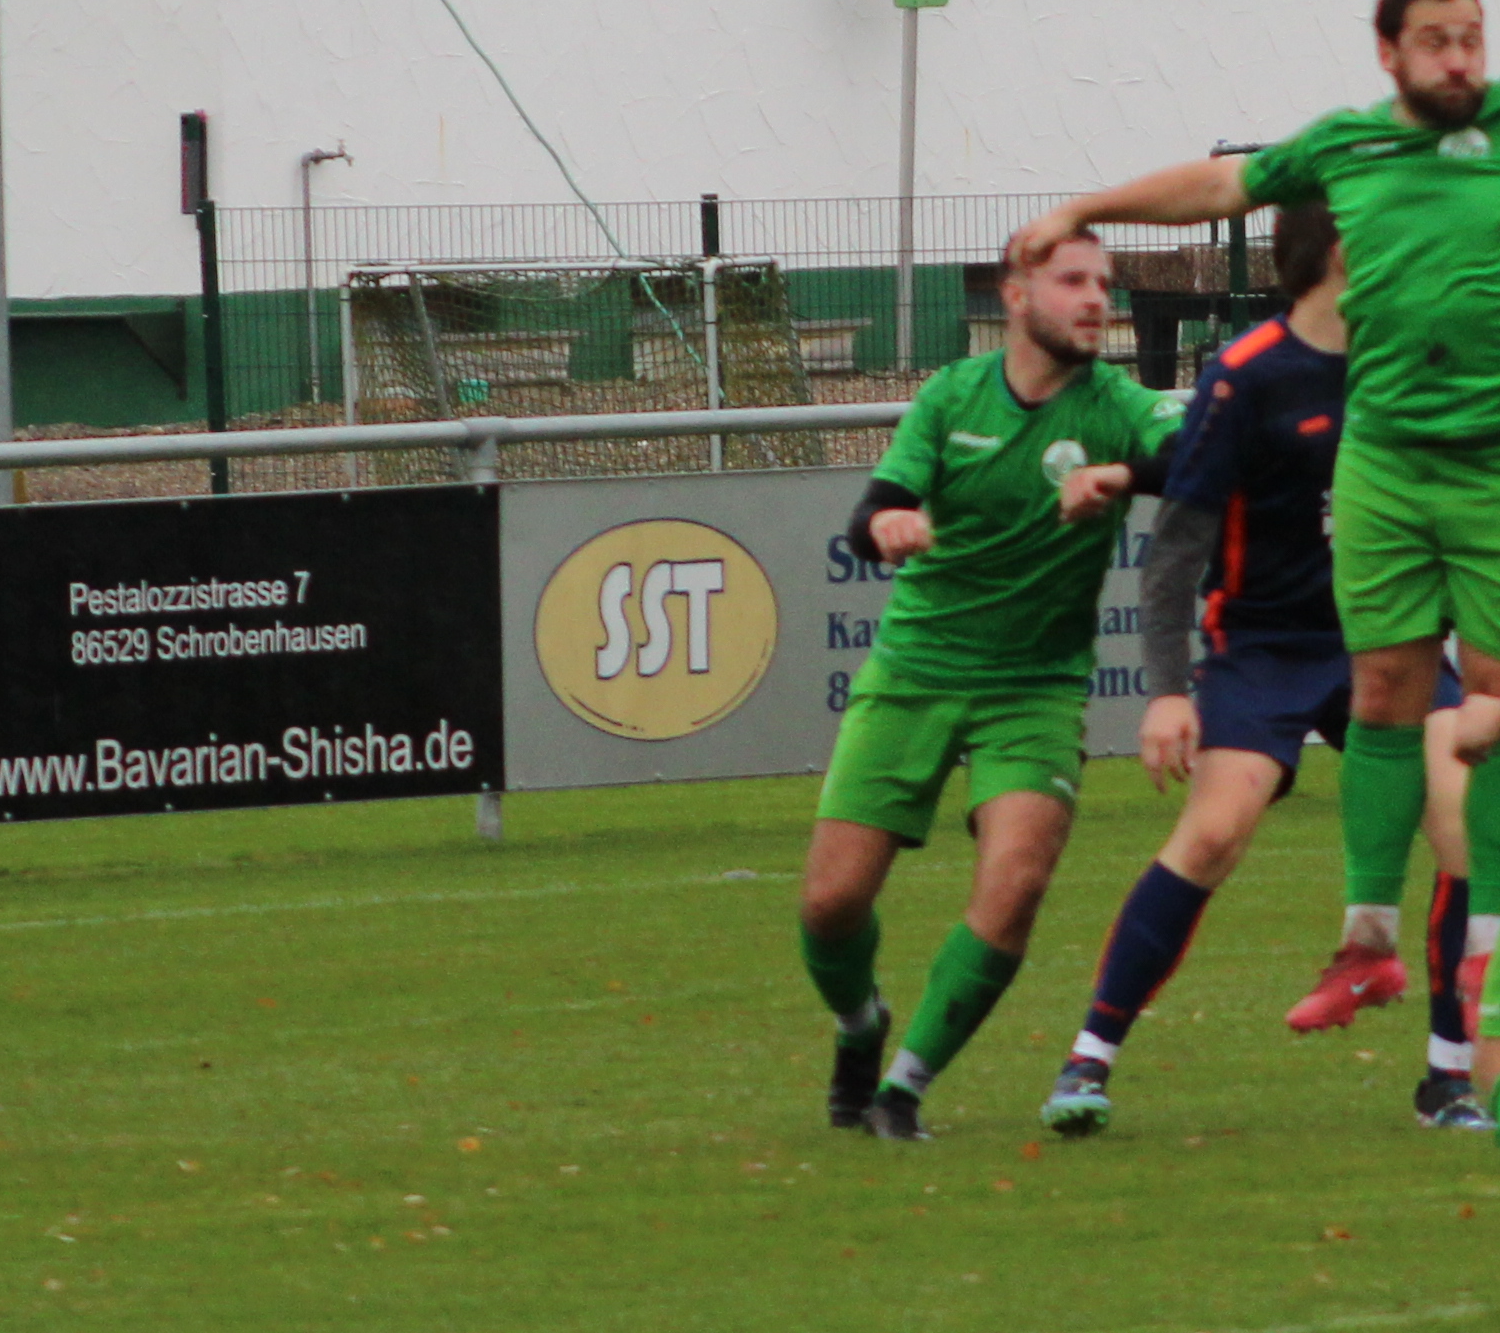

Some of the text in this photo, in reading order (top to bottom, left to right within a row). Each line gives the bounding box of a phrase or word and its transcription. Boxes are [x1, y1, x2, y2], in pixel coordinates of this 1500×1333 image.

[69, 571, 311, 616] Pestalozzistrasse 7
[596, 558, 725, 681] SST
[71, 621, 367, 665] 86529 Schrobenhausen
